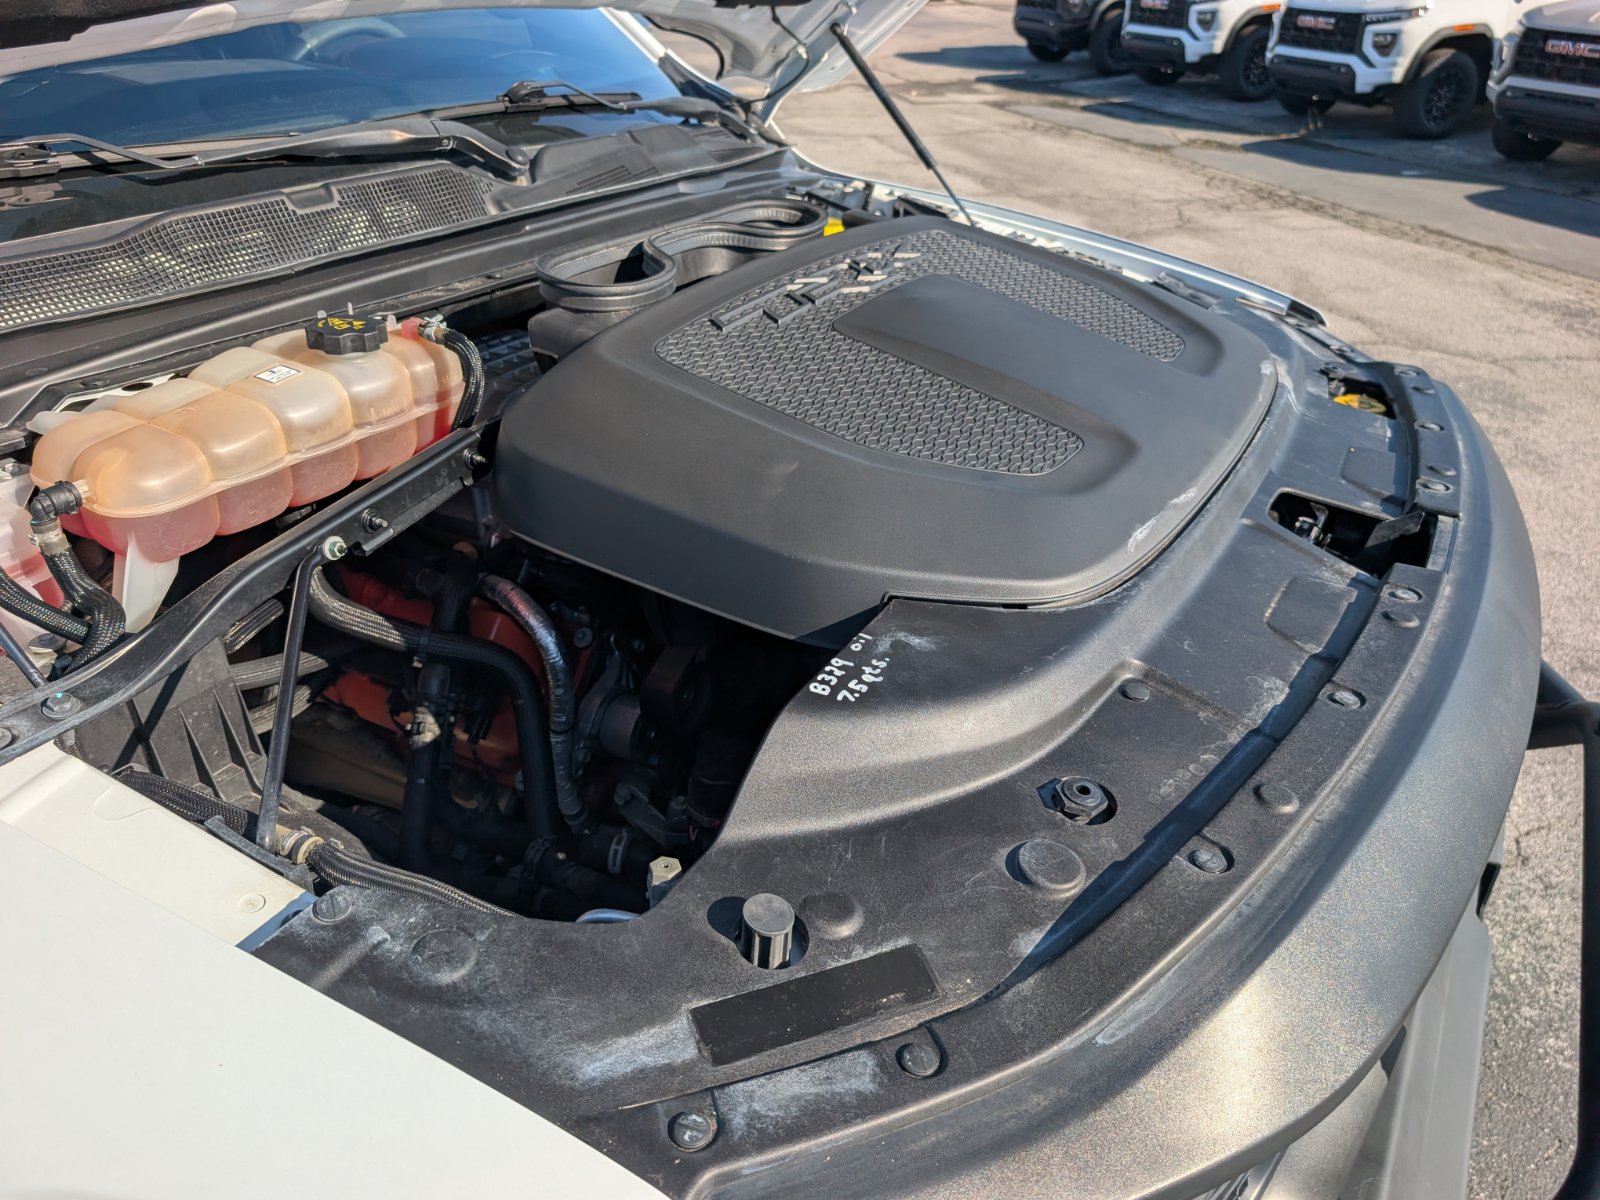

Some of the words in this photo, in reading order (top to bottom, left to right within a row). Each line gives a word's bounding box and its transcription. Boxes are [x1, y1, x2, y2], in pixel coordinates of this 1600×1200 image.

[1296, 14, 1336, 30] GMC
[1545, 39, 1600, 58] GMC
[836, 679, 869, 702] 7.5
[861, 657, 891, 682] qts.
